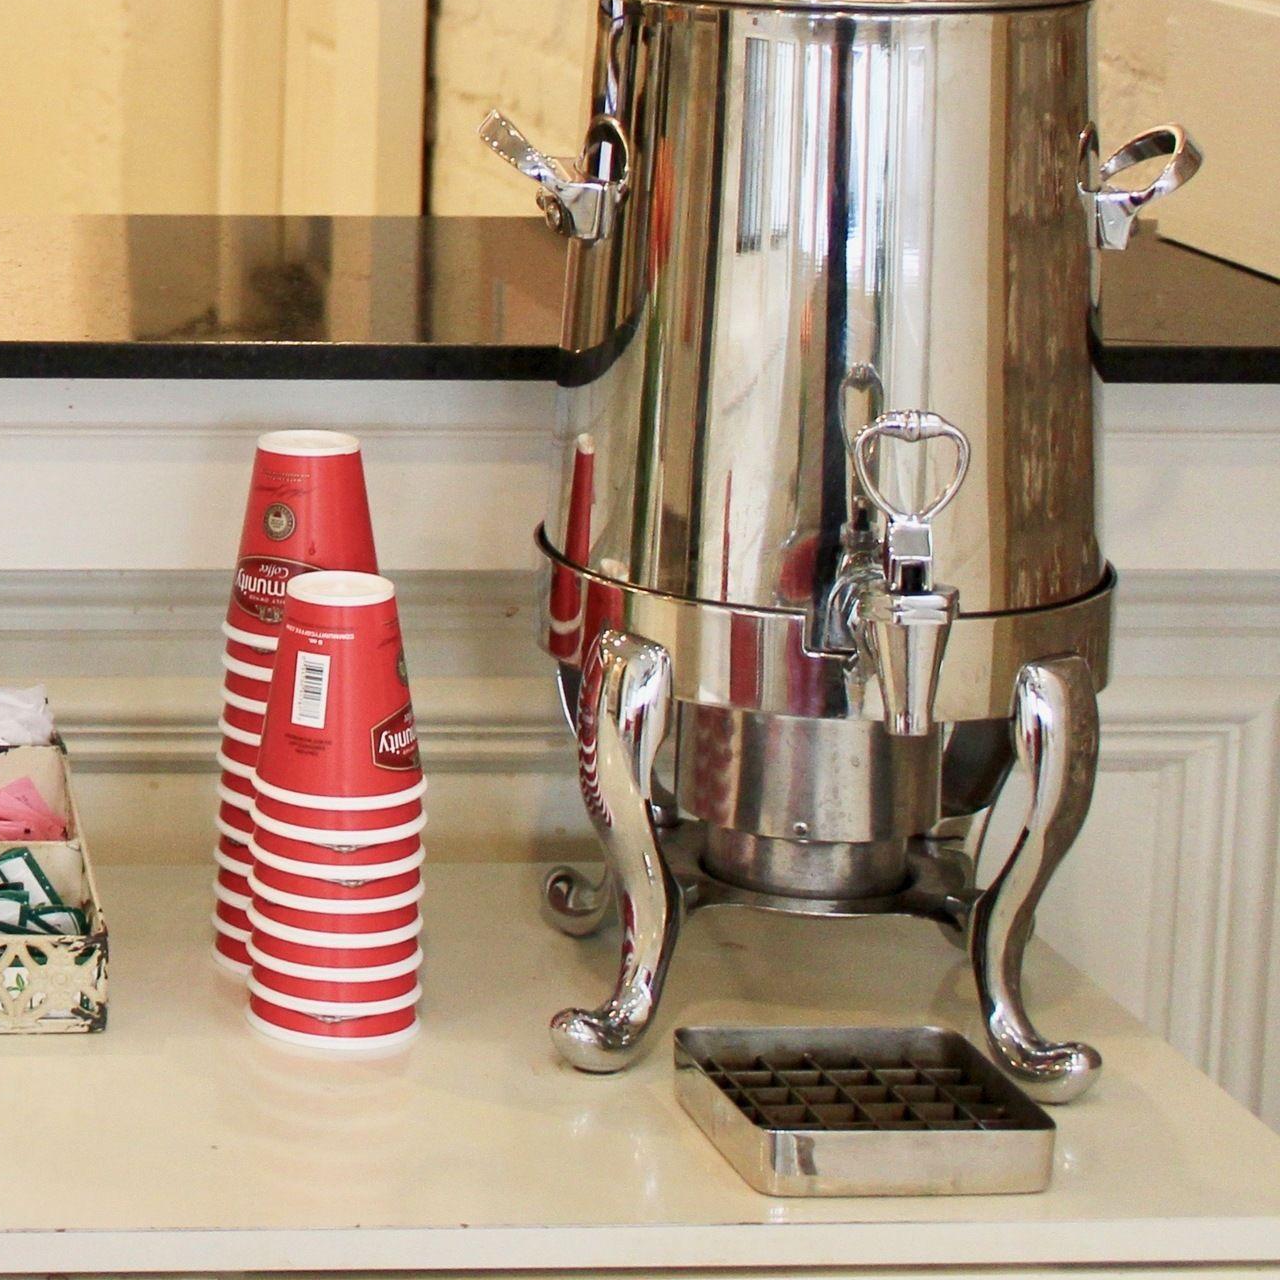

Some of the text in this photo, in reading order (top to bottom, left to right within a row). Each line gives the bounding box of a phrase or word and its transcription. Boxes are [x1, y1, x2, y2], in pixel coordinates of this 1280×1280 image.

[235, 567, 286, 597] munity
[259, 563, 289, 579] Coffee
[378, 727, 414, 755] unity
